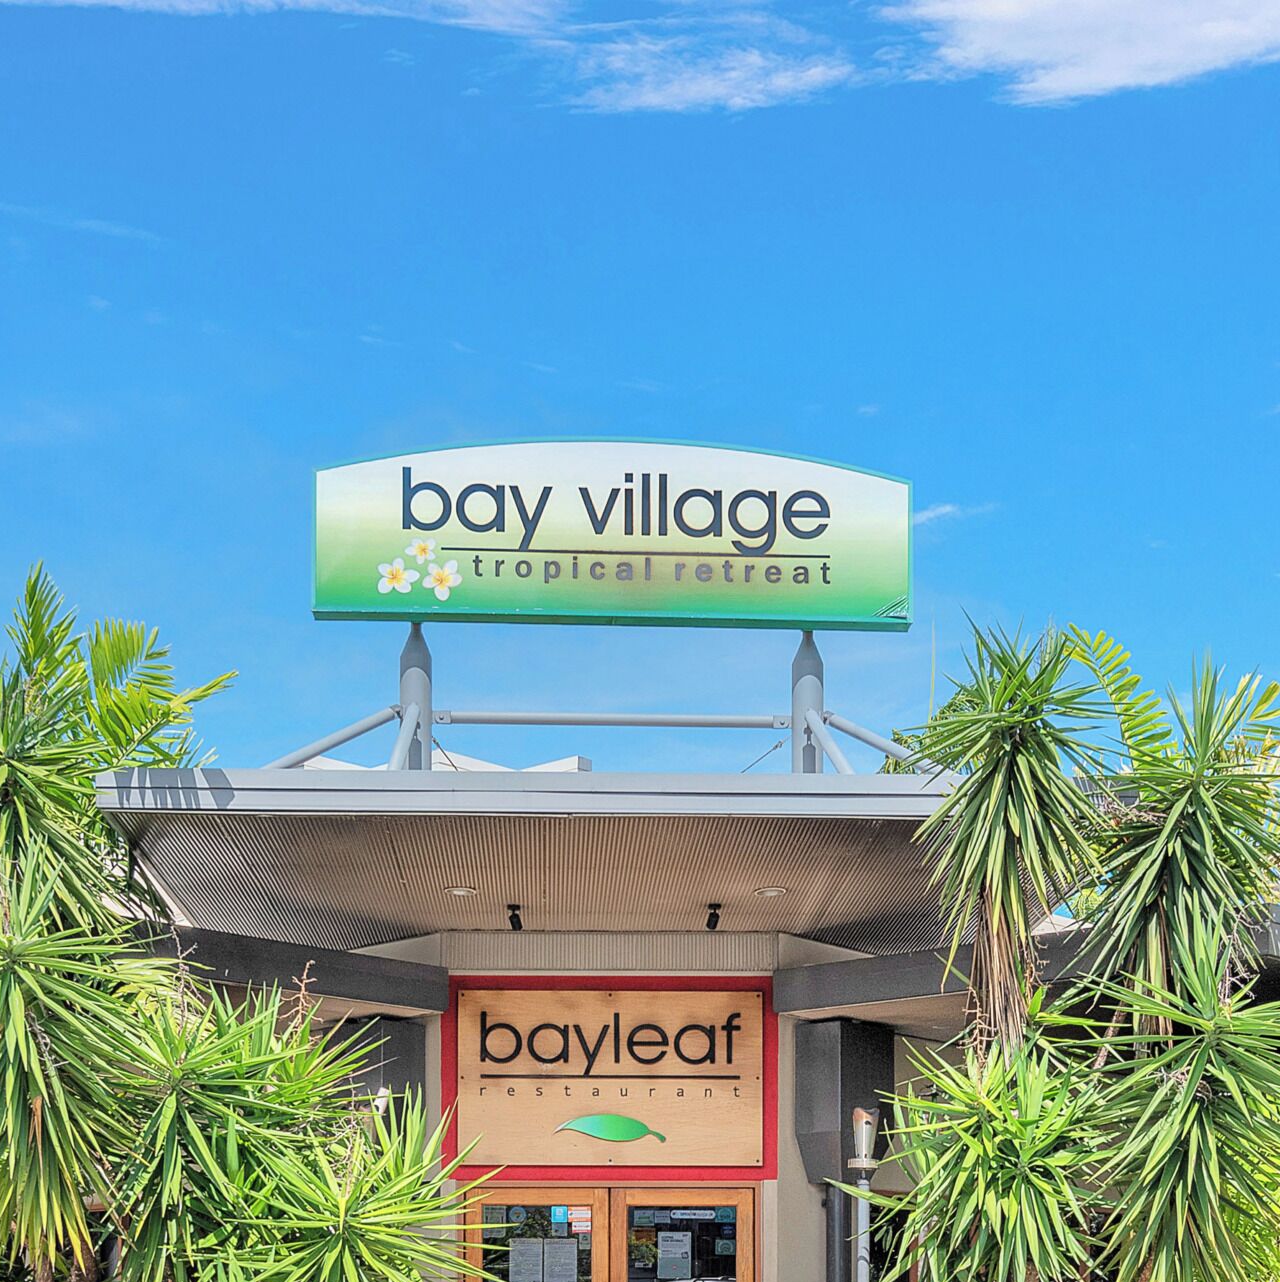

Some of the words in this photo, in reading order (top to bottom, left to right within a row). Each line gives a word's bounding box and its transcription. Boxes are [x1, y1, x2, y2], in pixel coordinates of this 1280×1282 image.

[401, 466, 553, 551] bay
[577, 472, 832, 557] village
[472, 554, 652, 584] tropical
[674, 559, 832, 585] retreat
[479, 1010, 742, 1076] bayleaf
[479, 1084, 741, 1099] restaurant
